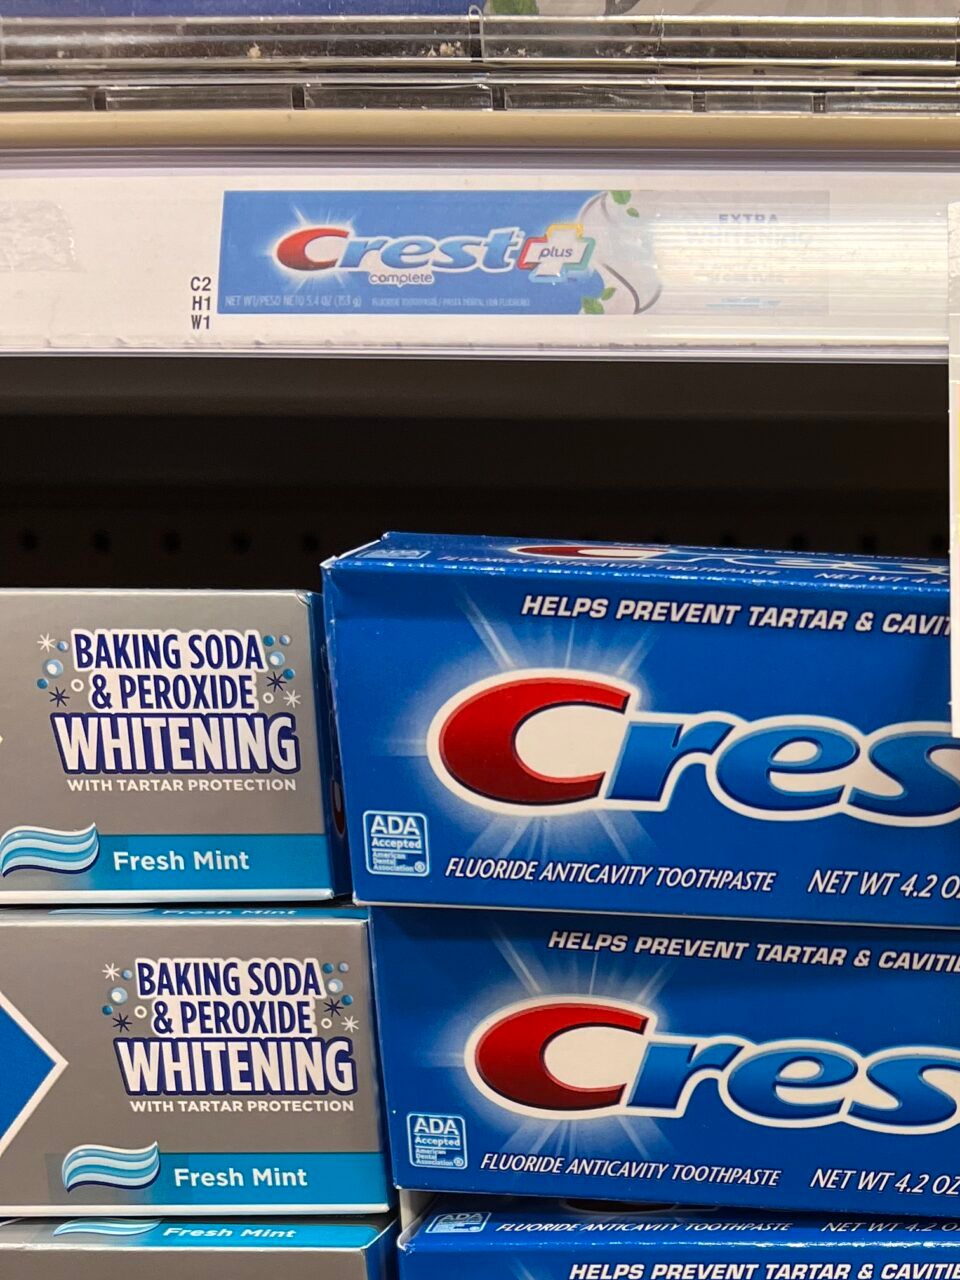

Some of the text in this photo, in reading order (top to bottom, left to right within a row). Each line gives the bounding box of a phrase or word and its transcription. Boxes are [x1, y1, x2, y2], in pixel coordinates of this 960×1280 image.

[274, 226, 524, 273] Crest
[538, 246, 573, 259] plus
[191, 277, 212, 292] C2
[369, 272, 434, 285] complete
[192, 296, 211, 311] H1
[191, 316, 211, 330] W1
[74, 632, 264, 670] BAKING SODA
[92, 674, 255, 710] & PEROXIDE
[51, 713, 300, 774] WHITENING
[67, 779, 297, 792] WITH TARTAR PROTECTION
[371, 815, 421, 836] ADA
[371, 838, 422, 850] Accepted
[113, 850, 250, 872] Fresh Mint
[445, 857, 539, 882] FLUORIDE
[539, 862, 653, 886] ANTICAVITY
[654, 867, 777, 893] TOOTHPASTE
[808, 869, 858, 894] NET
[860, 871, 900, 896] WT
[900, 873, 938, 898] 4.2
[549, 931, 628, 954] HELPS
[634, 936, 750, 961] PREVENT
[756, 943, 850, 967] TARTAR
[853, 950, 870, 968] &
